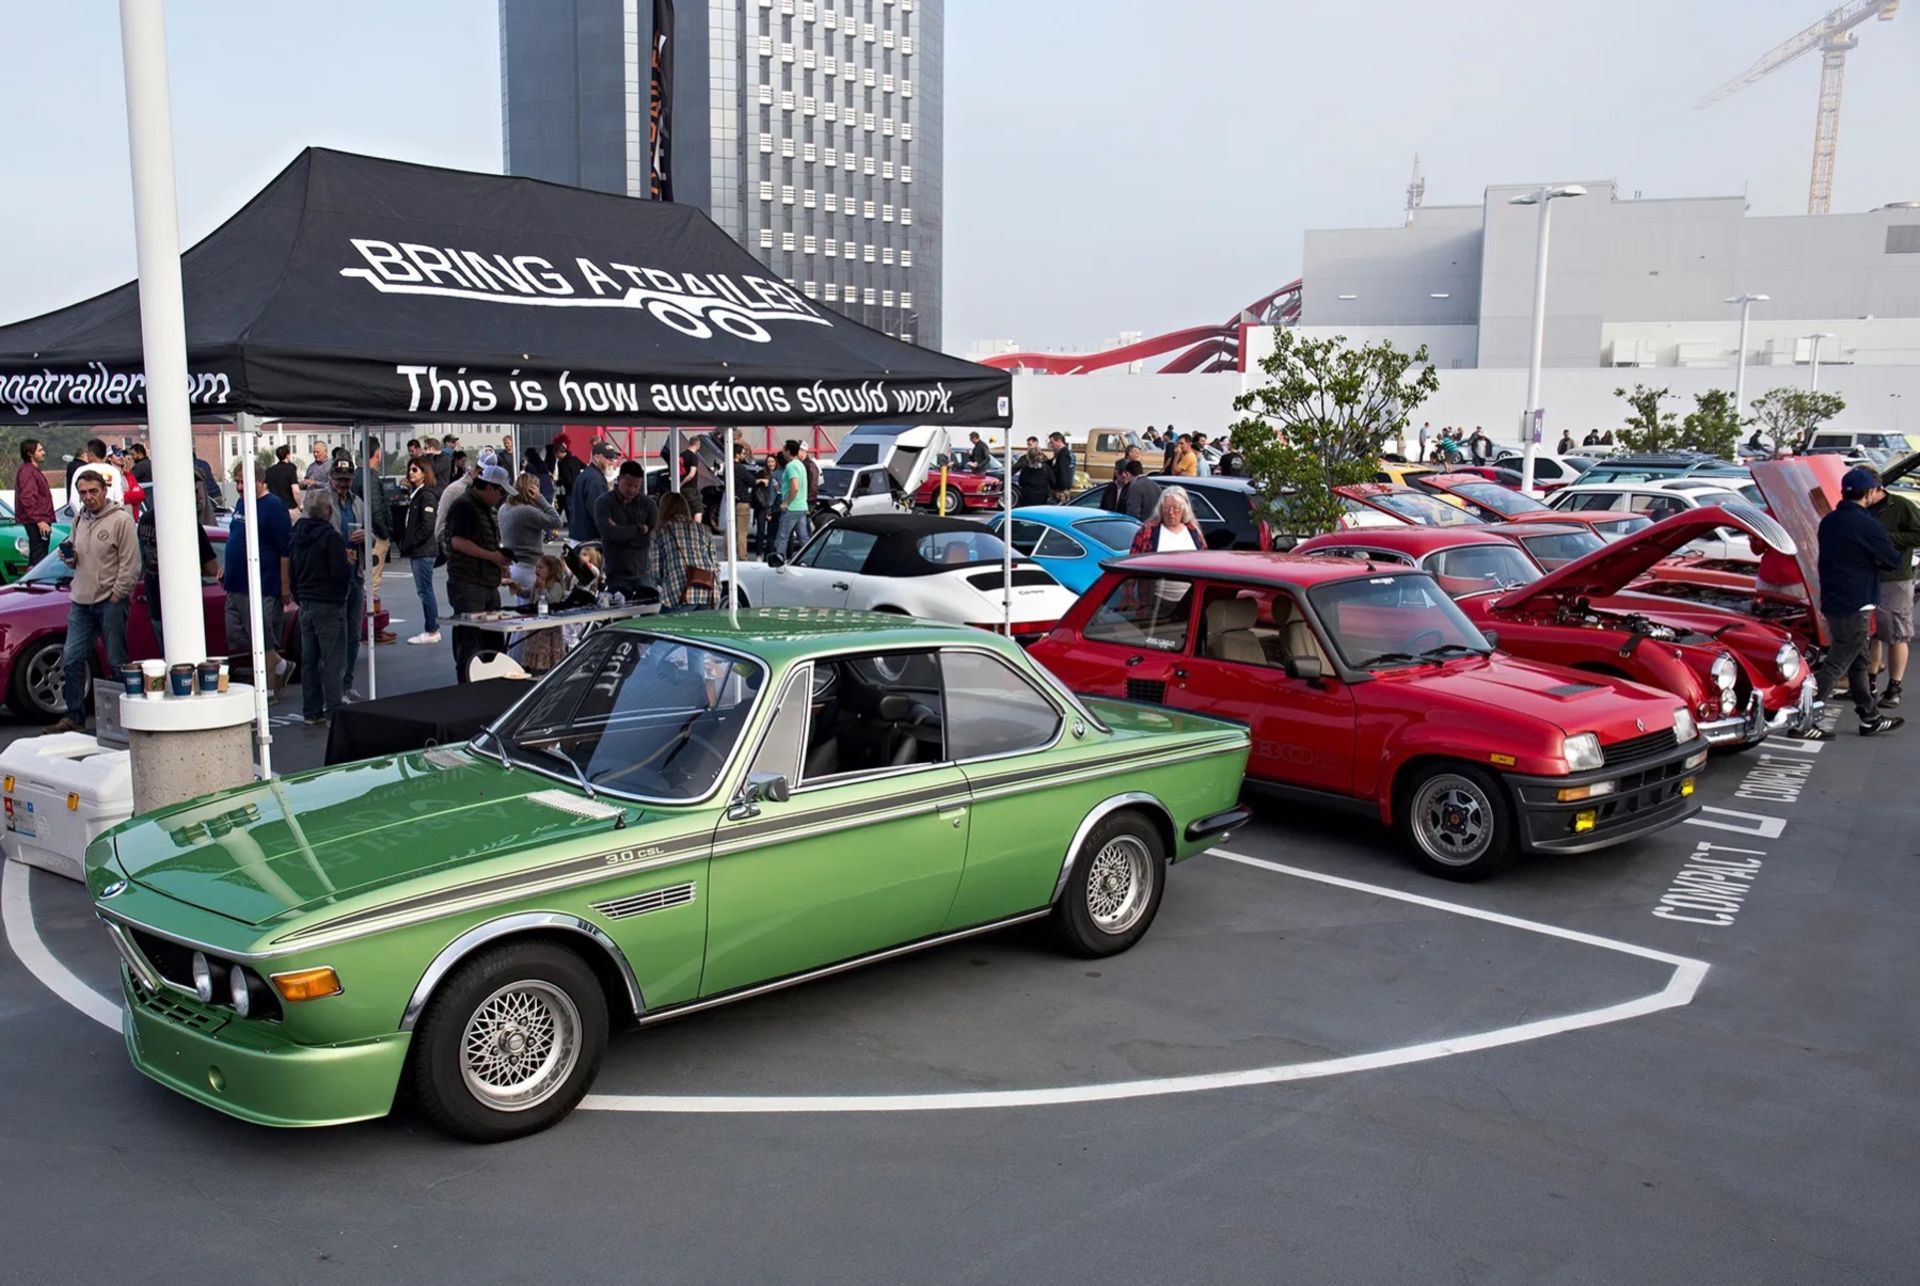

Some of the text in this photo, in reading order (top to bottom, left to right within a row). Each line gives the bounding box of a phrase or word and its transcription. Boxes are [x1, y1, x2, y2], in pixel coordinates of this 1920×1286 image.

[350, 238, 821, 318] BRING A TRAILER
[396, 365, 498, 412] This
[510, 368, 549, 412] is
[559, 370, 639, 412] how
[649, 376, 791, 413] auctions
[796, 379, 888, 413] should
[892, 382, 954, 414] work.
[1734, 753, 1816, 803] COMPACT
[605, 846, 665, 865] 3.0 CSL
[1651, 841, 1767, 926] COMPACT
